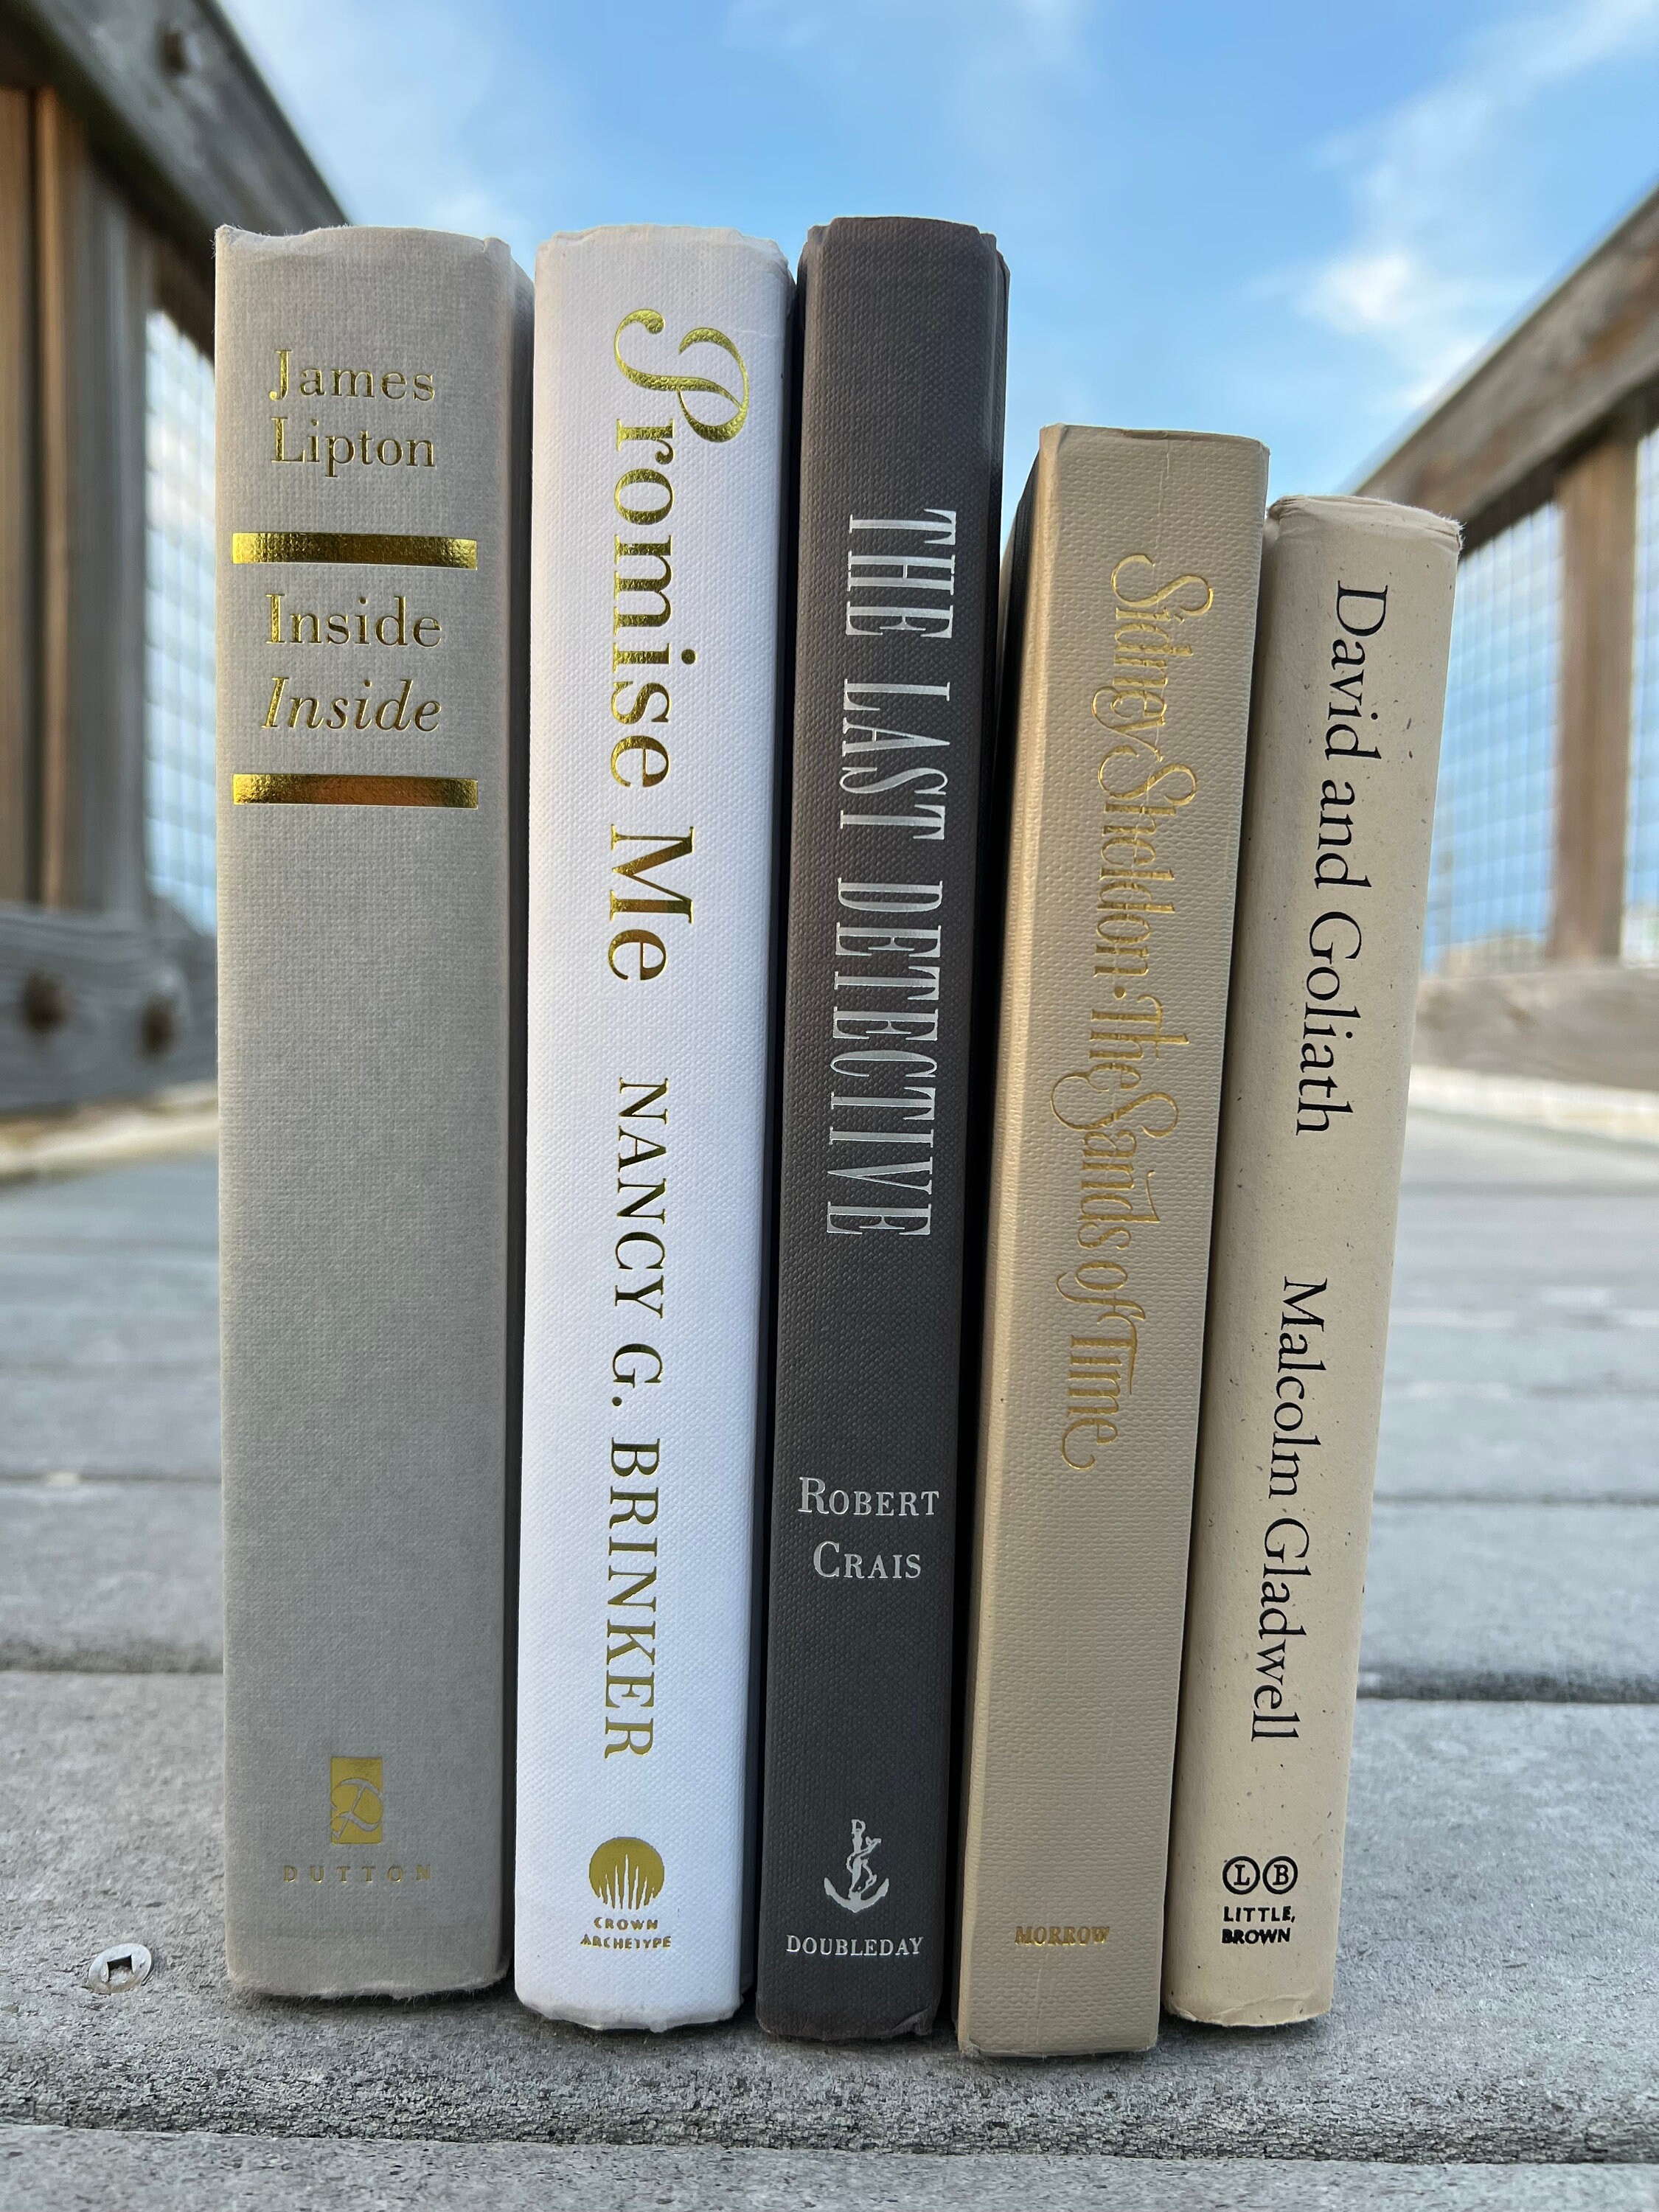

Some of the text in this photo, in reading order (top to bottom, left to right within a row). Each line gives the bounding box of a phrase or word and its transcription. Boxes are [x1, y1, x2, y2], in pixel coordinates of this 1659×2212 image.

[268, 349, 436, 402] James
[270, 417, 436, 478] Lipton
[265, 594, 442, 647] Inside
[608, 307, 749, 981] Promise Me
[262, 677, 442, 732] Inside
[827, 508, 956, 1236] THE LAST DETECTIVE
[1295, 580, 1388, 1136] David and Goliath
[1050, 553, 1214, 1471] Sidney Sheldon The Sands of Time
[605, 1077, 669, 1759] NANCY G. BRINKER
[797, 1476, 940, 1517] ROBERT
[1251, 1276, 1328, 1742] Malcolm Gladwell
[813, 1540, 922, 1579] CRAIS
[283, 1864, 431, 1885] DUTTON
[593, 1916, 659, 1931] CROWN
[1014, 1926, 1110, 1946] MORROW
[1221, 1927, 1291, 1946] BROWN
[1222, 1905, 1296, 1924] LITTLE,
[580, 1933, 672, 1950] ARCHETYPE
[786, 1934, 924, 1956] DOUBLEDAY
